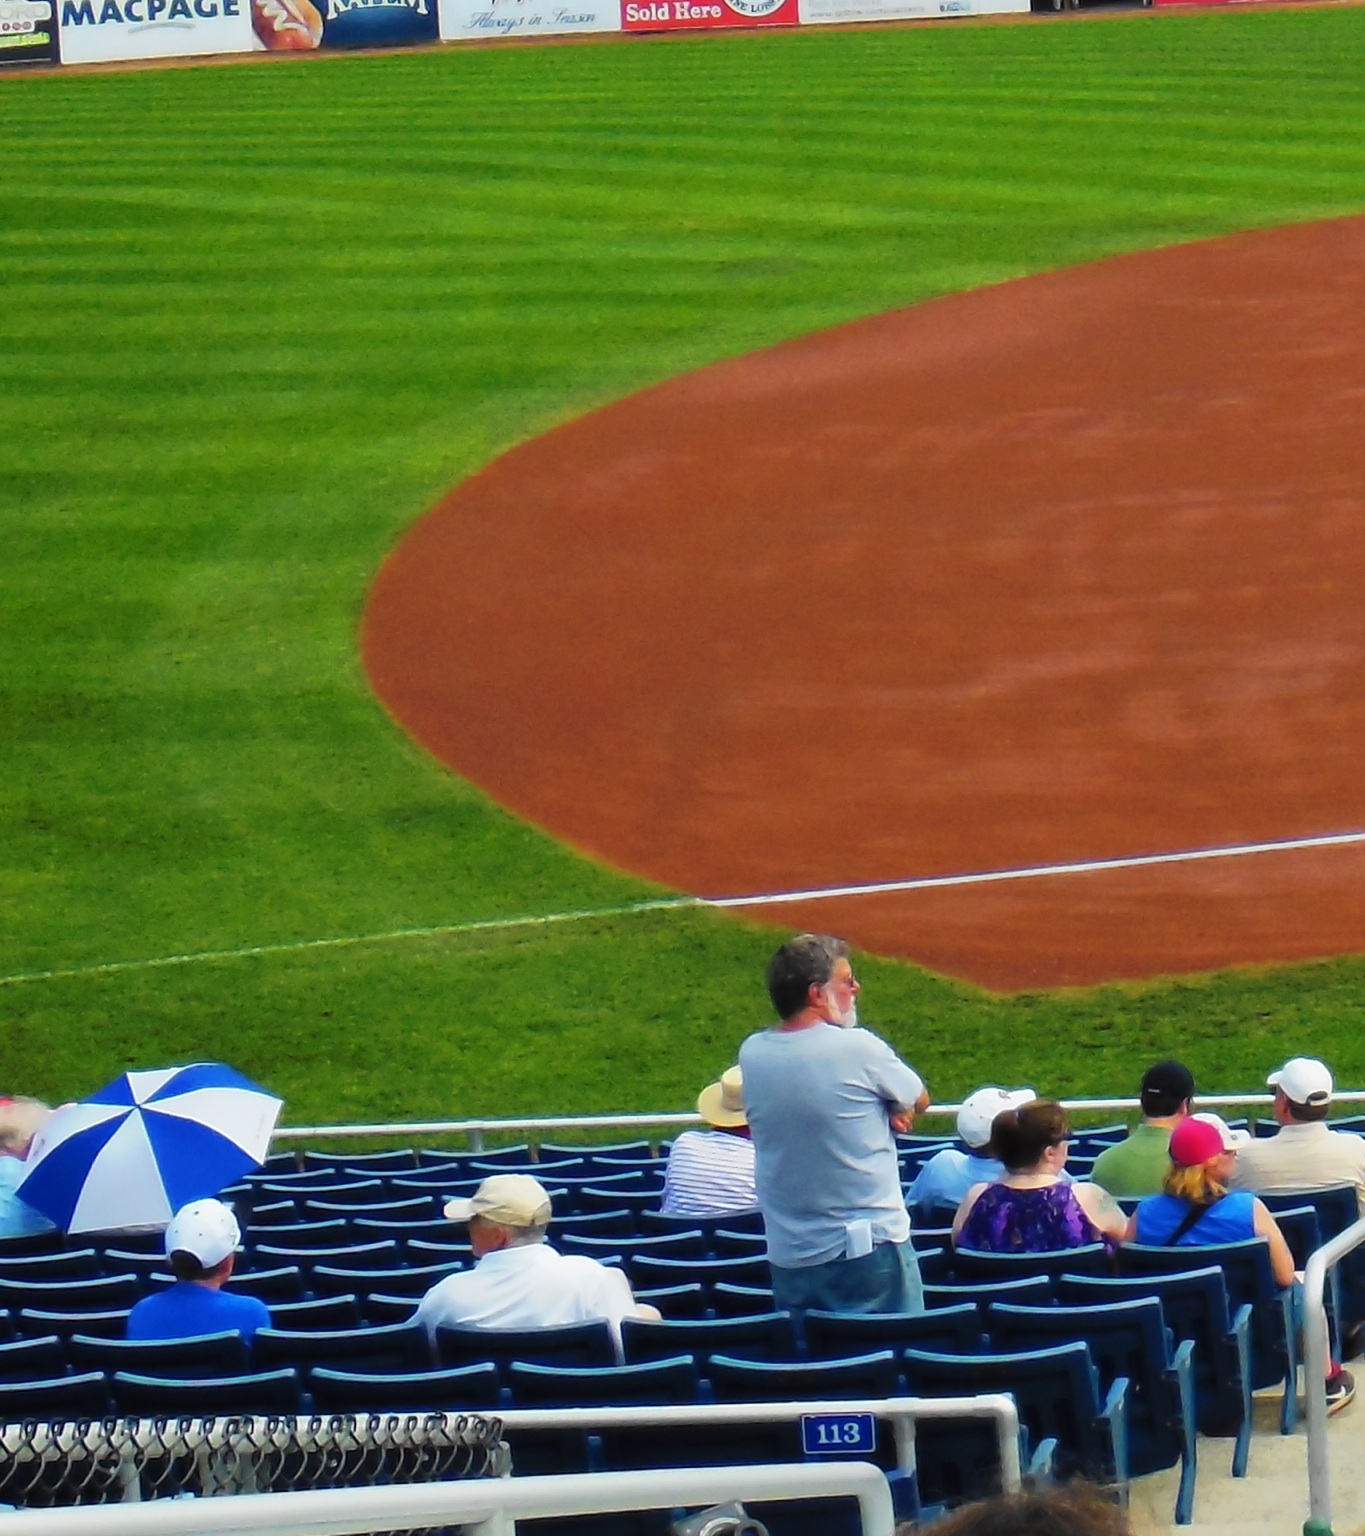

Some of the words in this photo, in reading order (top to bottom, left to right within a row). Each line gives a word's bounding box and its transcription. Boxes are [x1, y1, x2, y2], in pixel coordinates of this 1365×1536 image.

[626, 3, 669, 22] Sold
[674, 1, 722, 20] Here
[817, 1422, 861, 1445] 113
